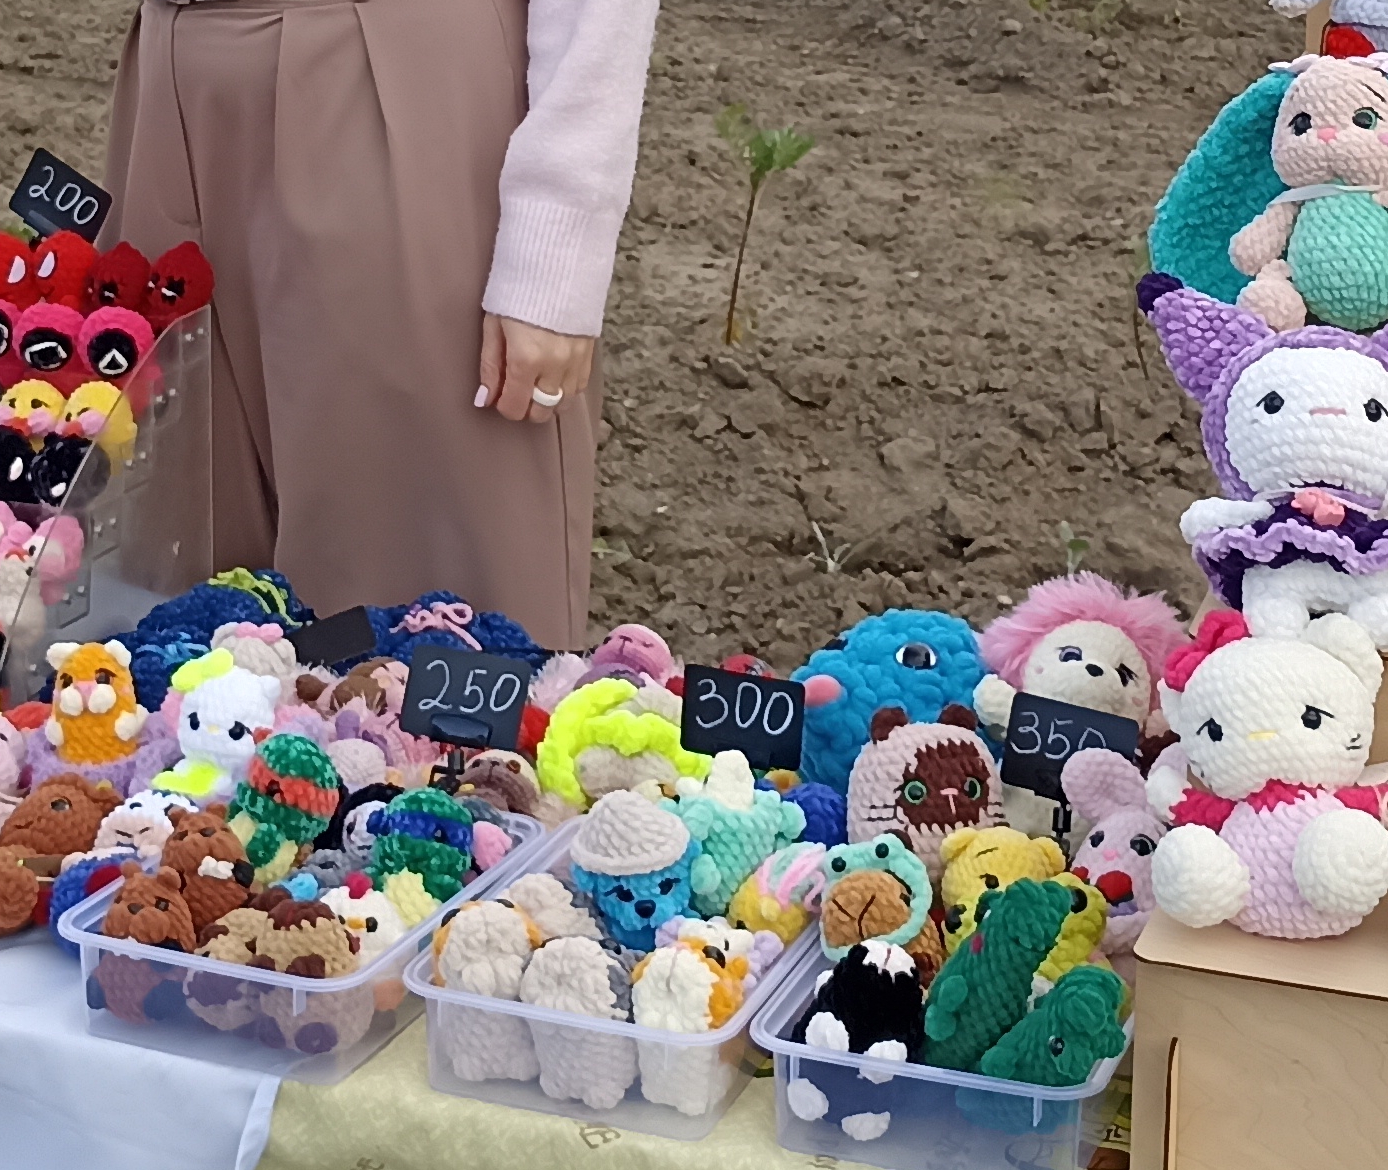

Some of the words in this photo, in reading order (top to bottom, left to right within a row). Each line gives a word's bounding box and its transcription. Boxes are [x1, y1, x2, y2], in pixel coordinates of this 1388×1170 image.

[28, 165, 99, 225] 200
[418, 659, 521, 713] 250
[695, 678, 795, 736] 300
[1010, 711, 1107, 760] 350
